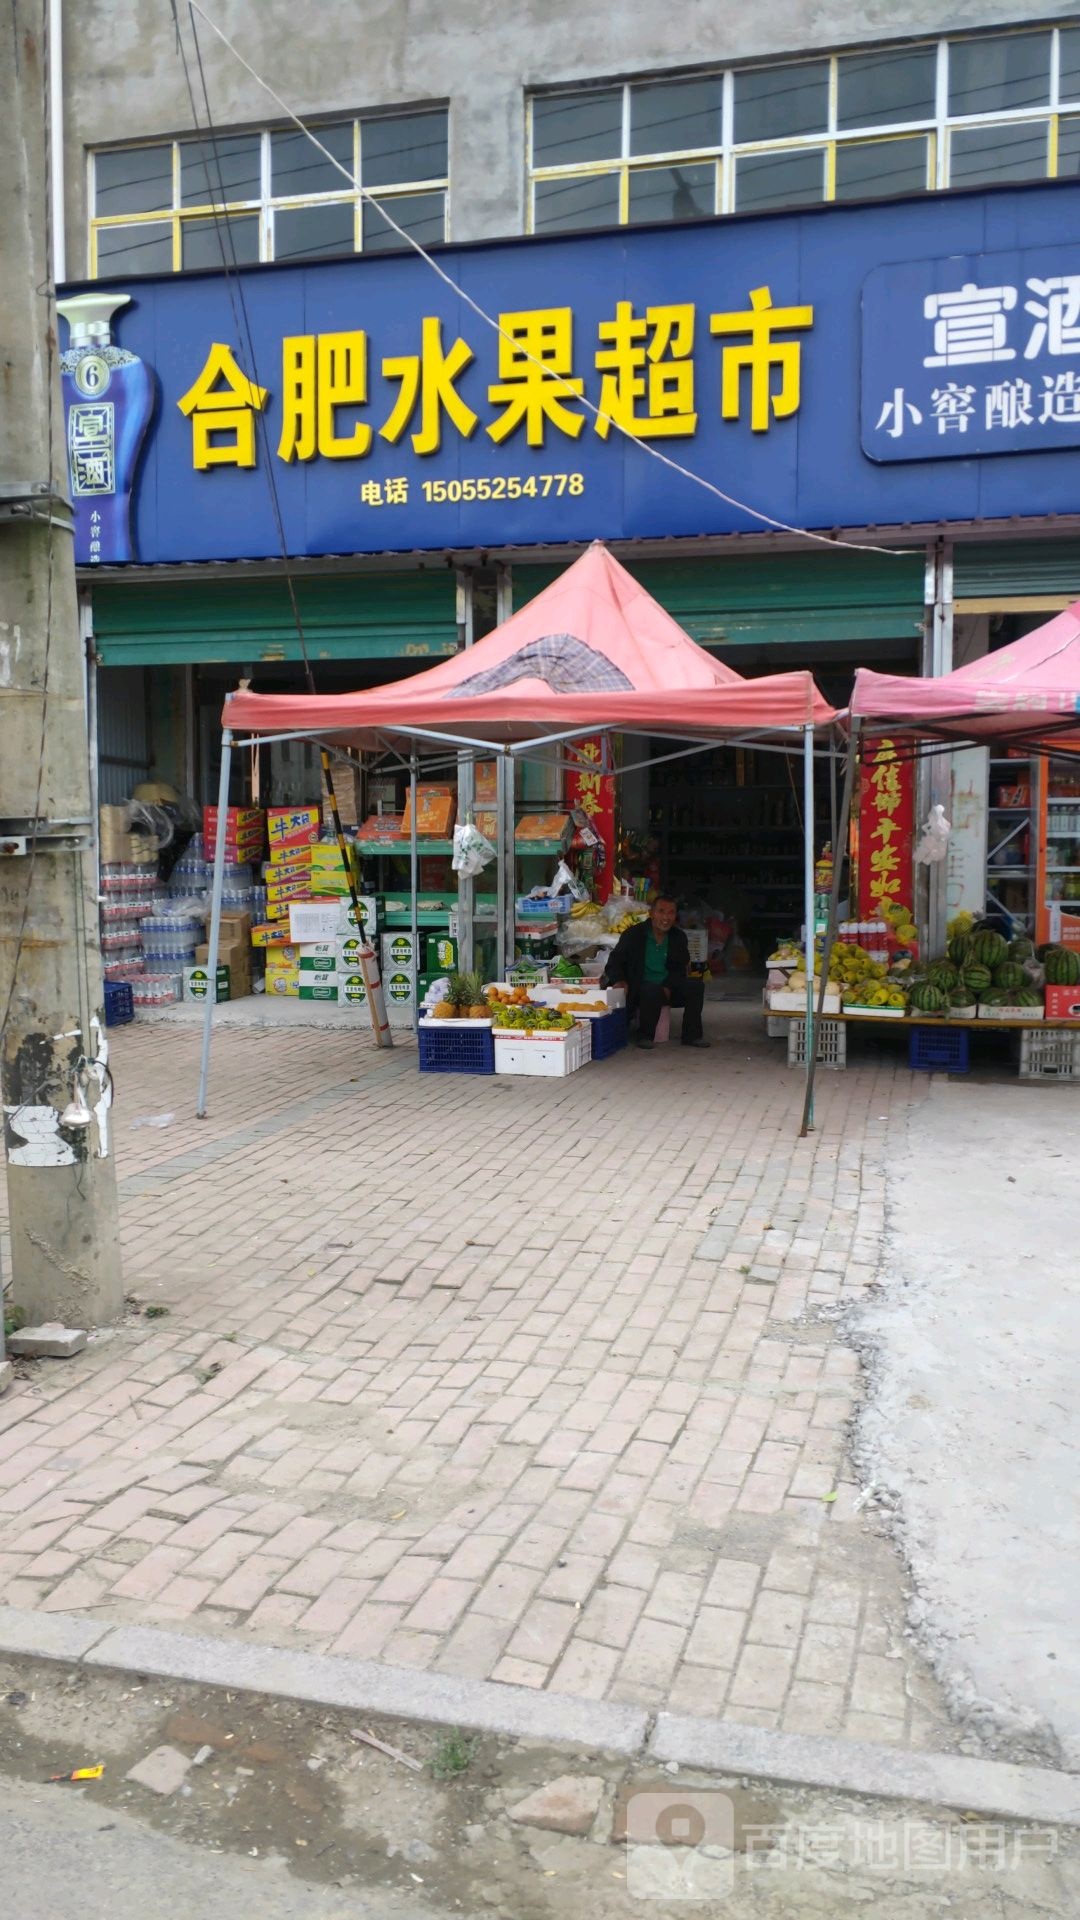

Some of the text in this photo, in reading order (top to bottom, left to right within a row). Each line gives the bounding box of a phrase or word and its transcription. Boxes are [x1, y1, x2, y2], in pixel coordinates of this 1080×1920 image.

[923, 275, 1080, 368] 宣酒
[85, 364, 99, 387] 6
[177, 286, 813, 470] 合肥水果超市
[875, 371, 1080, 438] 小窖酿造
[361, 473, 584, 505] 电话 15055254778
